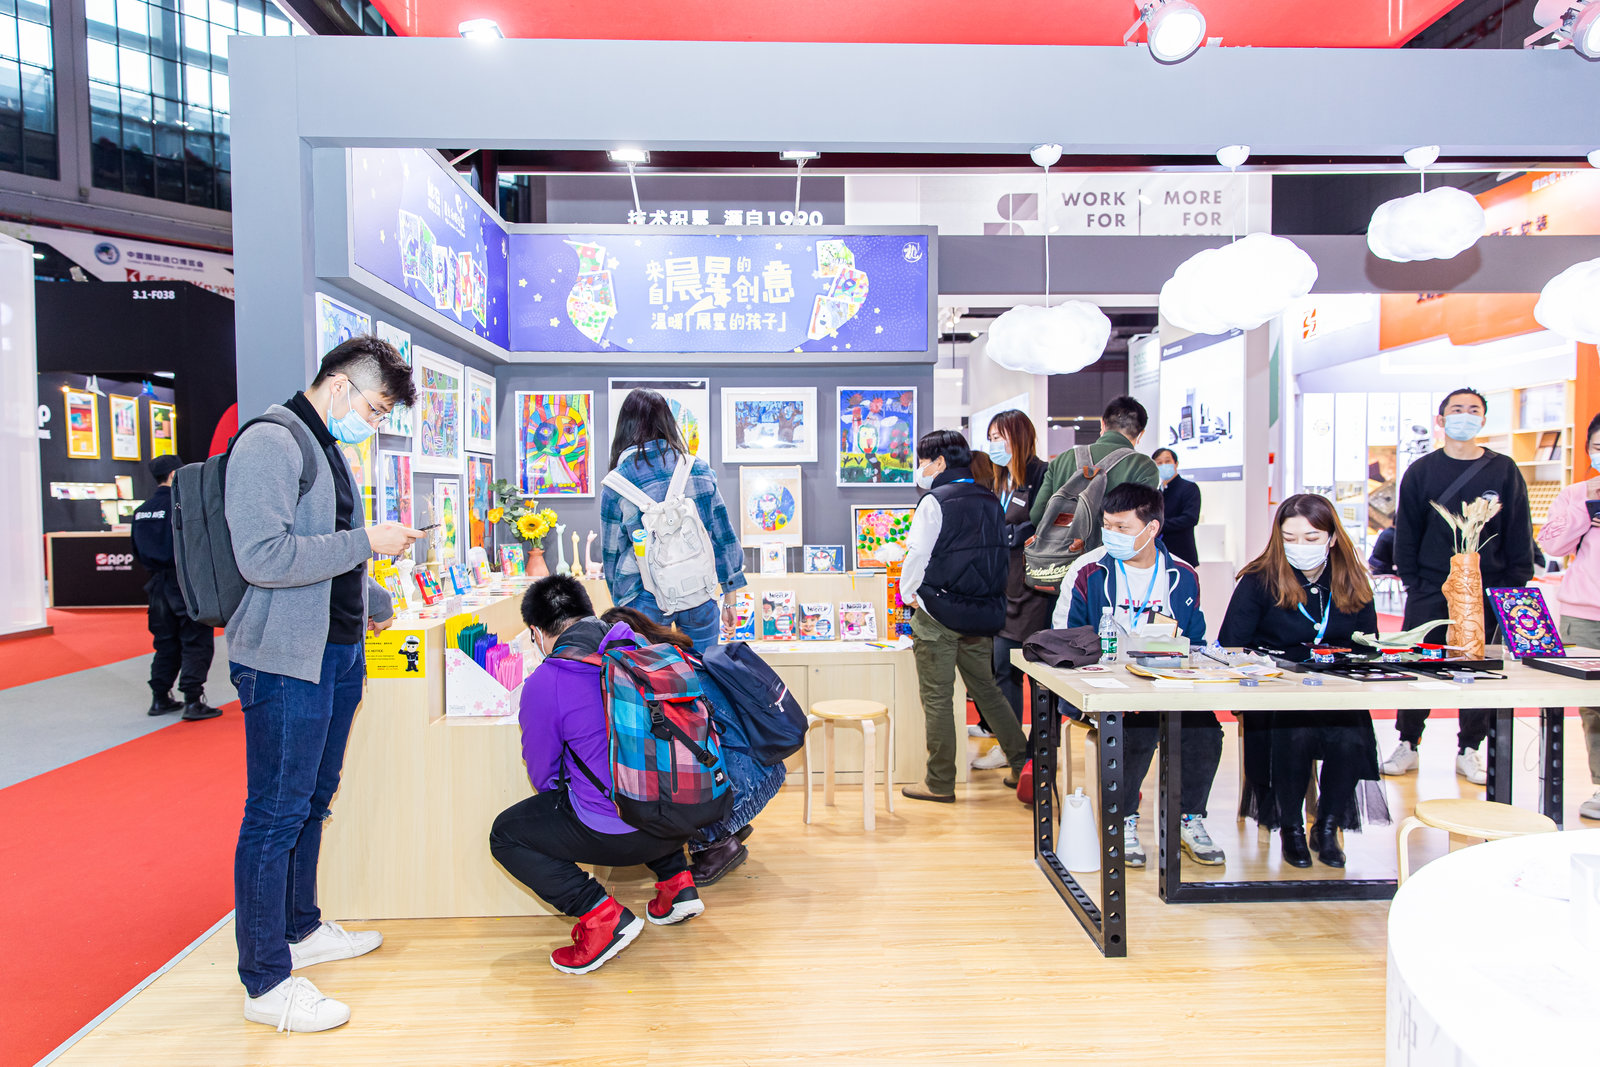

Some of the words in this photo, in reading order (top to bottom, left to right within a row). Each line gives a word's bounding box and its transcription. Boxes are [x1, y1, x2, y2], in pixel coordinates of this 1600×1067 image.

[1062, 191, 1126, 207] WORK
[1164, 190, 1222, 205] MORE
[1086, 213, 1126, 228] FOR
[1183, 212, 1222, 227] FOR
[132, 290, 176, 300] 3.1-F038
